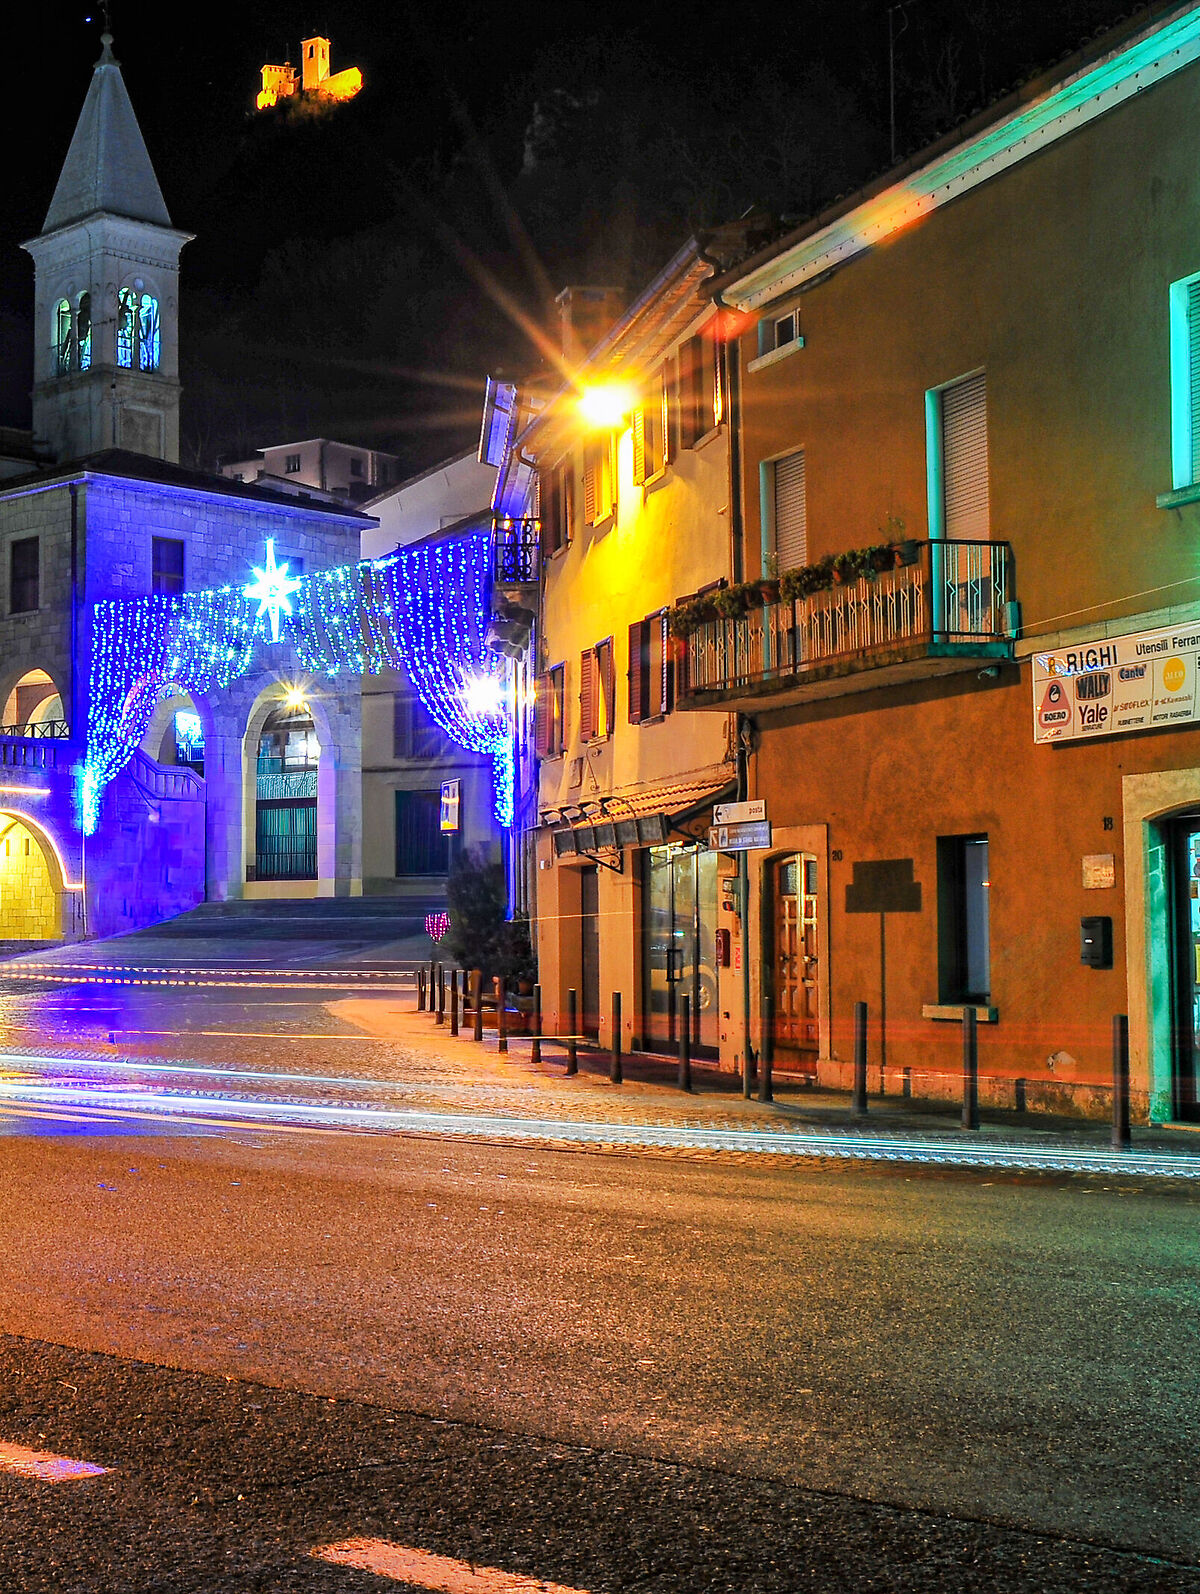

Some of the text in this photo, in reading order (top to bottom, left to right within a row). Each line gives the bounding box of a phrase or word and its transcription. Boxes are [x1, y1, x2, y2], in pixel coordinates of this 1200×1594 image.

[1066, 644, 1118, 673] RIGHI
[1135, 639, 1169, 656] Utensili
[1044, 711, 1067, 722] BOERO
[1079, 702, 1108, 725] Yale
[1103, 816, 1114, 831] 18
[831, 849, 843, 862] 20
